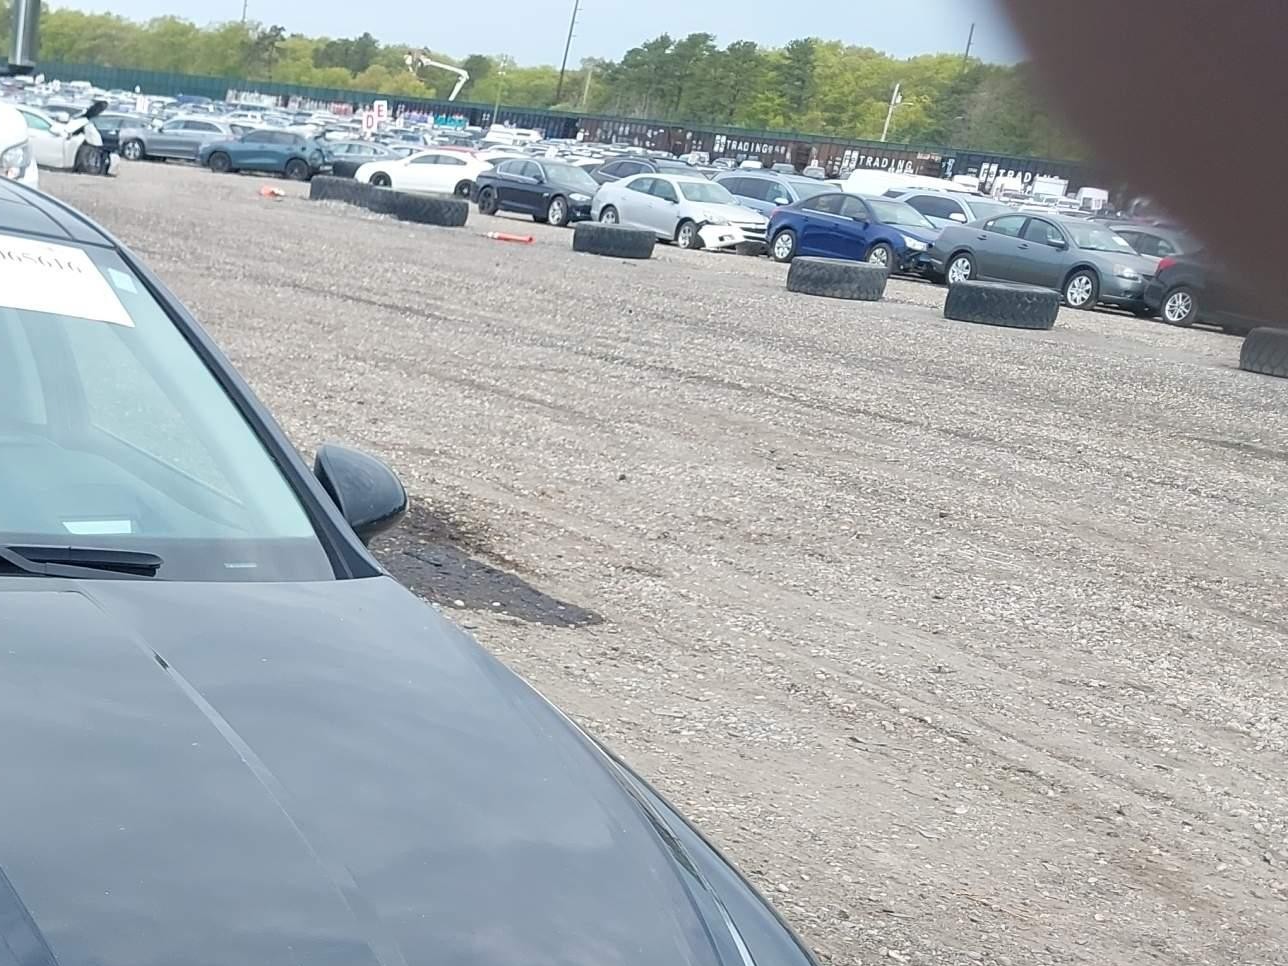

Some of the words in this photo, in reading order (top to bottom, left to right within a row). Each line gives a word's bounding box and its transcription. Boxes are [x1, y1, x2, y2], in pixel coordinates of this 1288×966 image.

[377, 104, 385, 118] E
[366, 114, 374, 129] D
[726, 140, 769, 154] TRADING
[859, 155, 913, 171] TRADING
[998, 169, 1059, 183] TRAD
